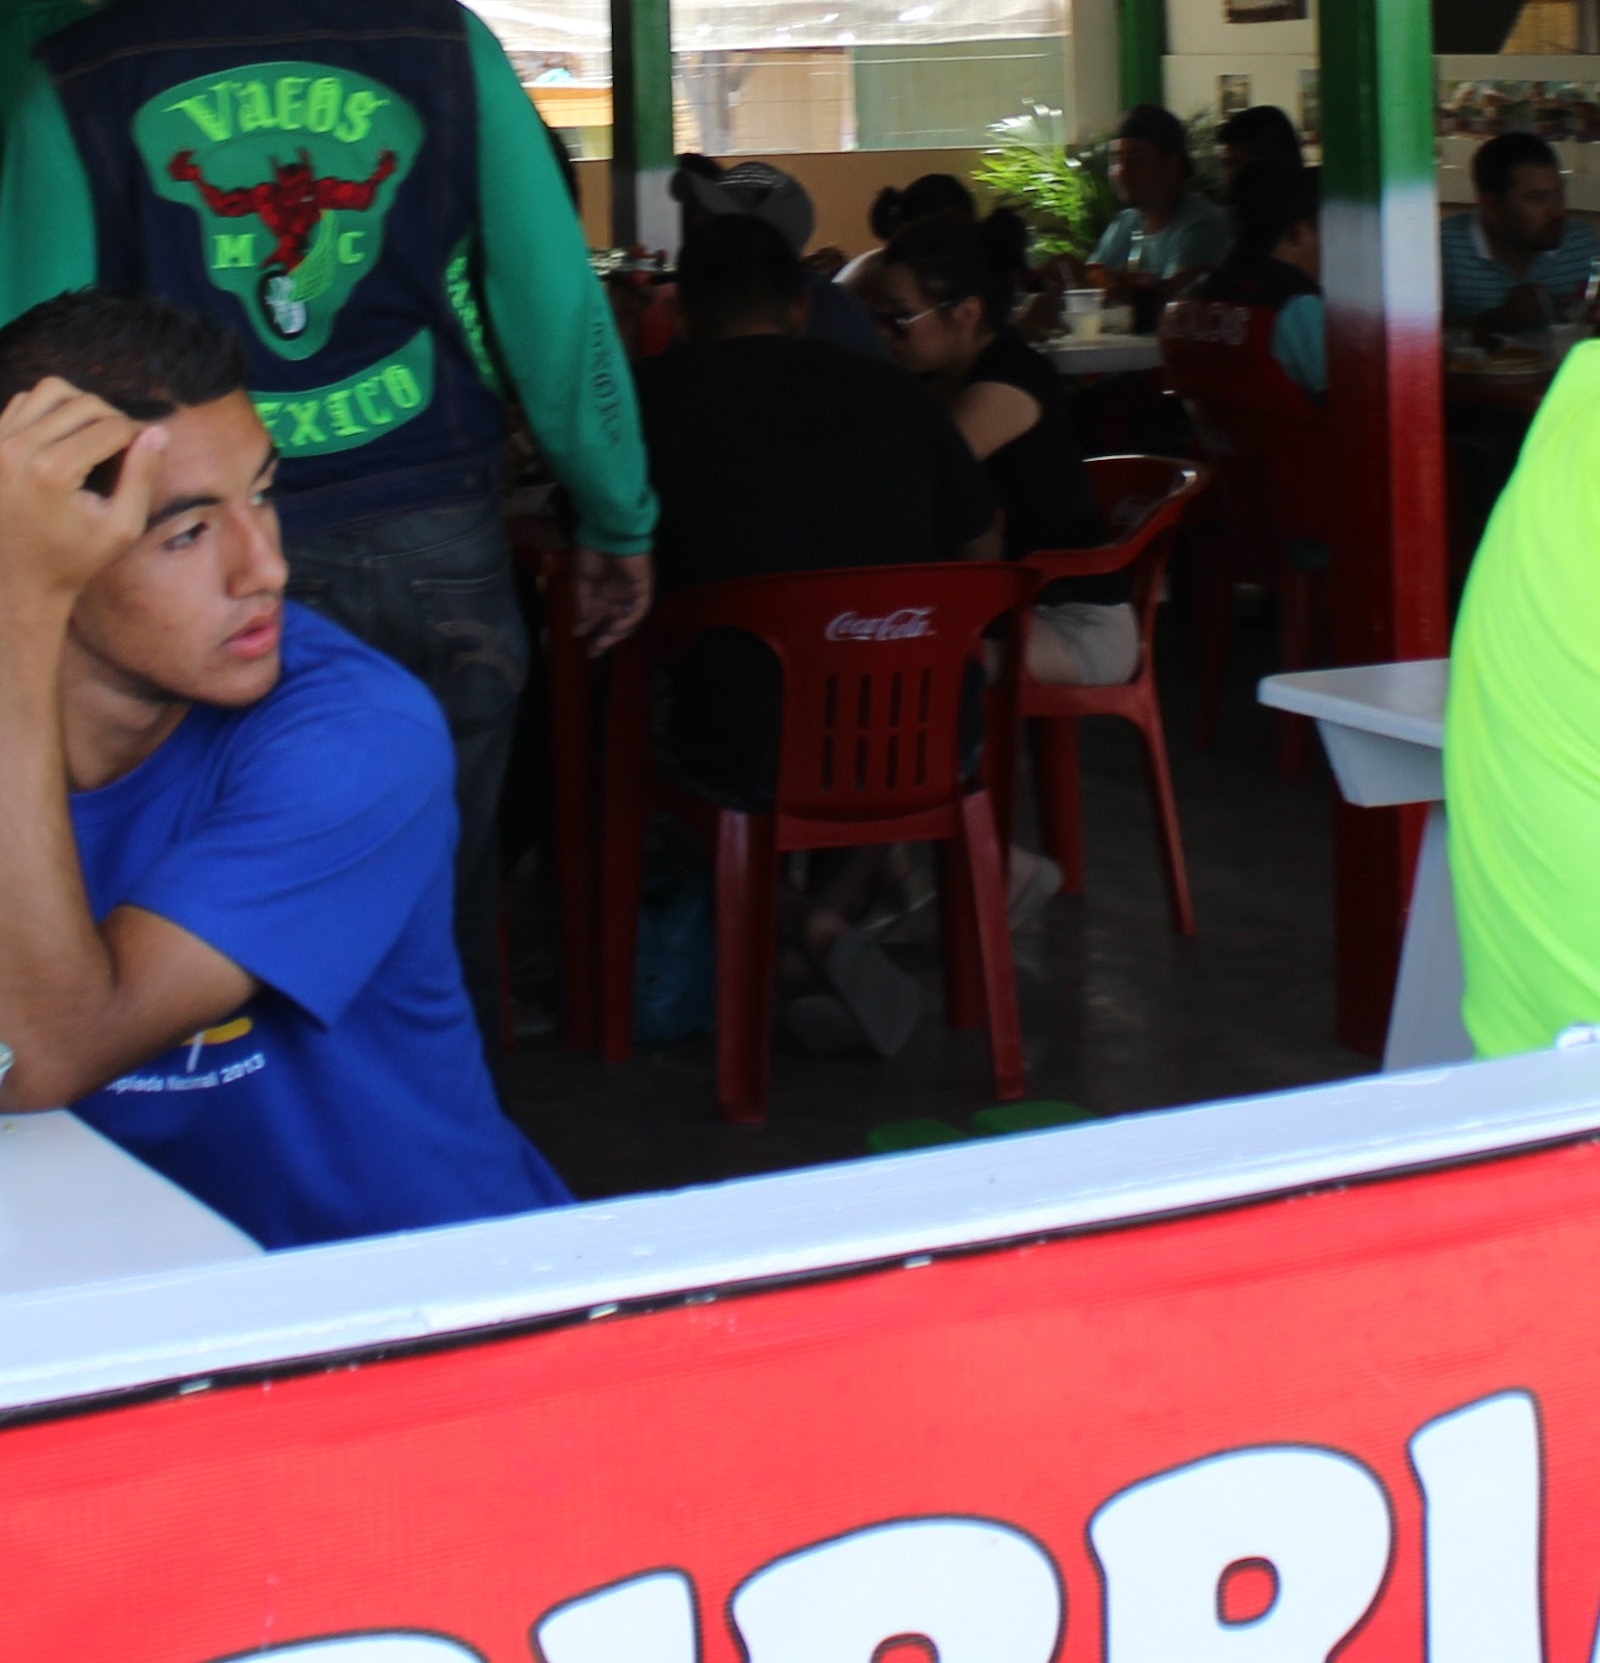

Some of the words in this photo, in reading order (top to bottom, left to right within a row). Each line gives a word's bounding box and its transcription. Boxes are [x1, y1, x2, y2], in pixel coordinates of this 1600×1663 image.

[254, 364, 423, 449] EXICO
[825, 607, 938, 641] Coca-Cola
[220, 1051, 267, 1086] 2013
